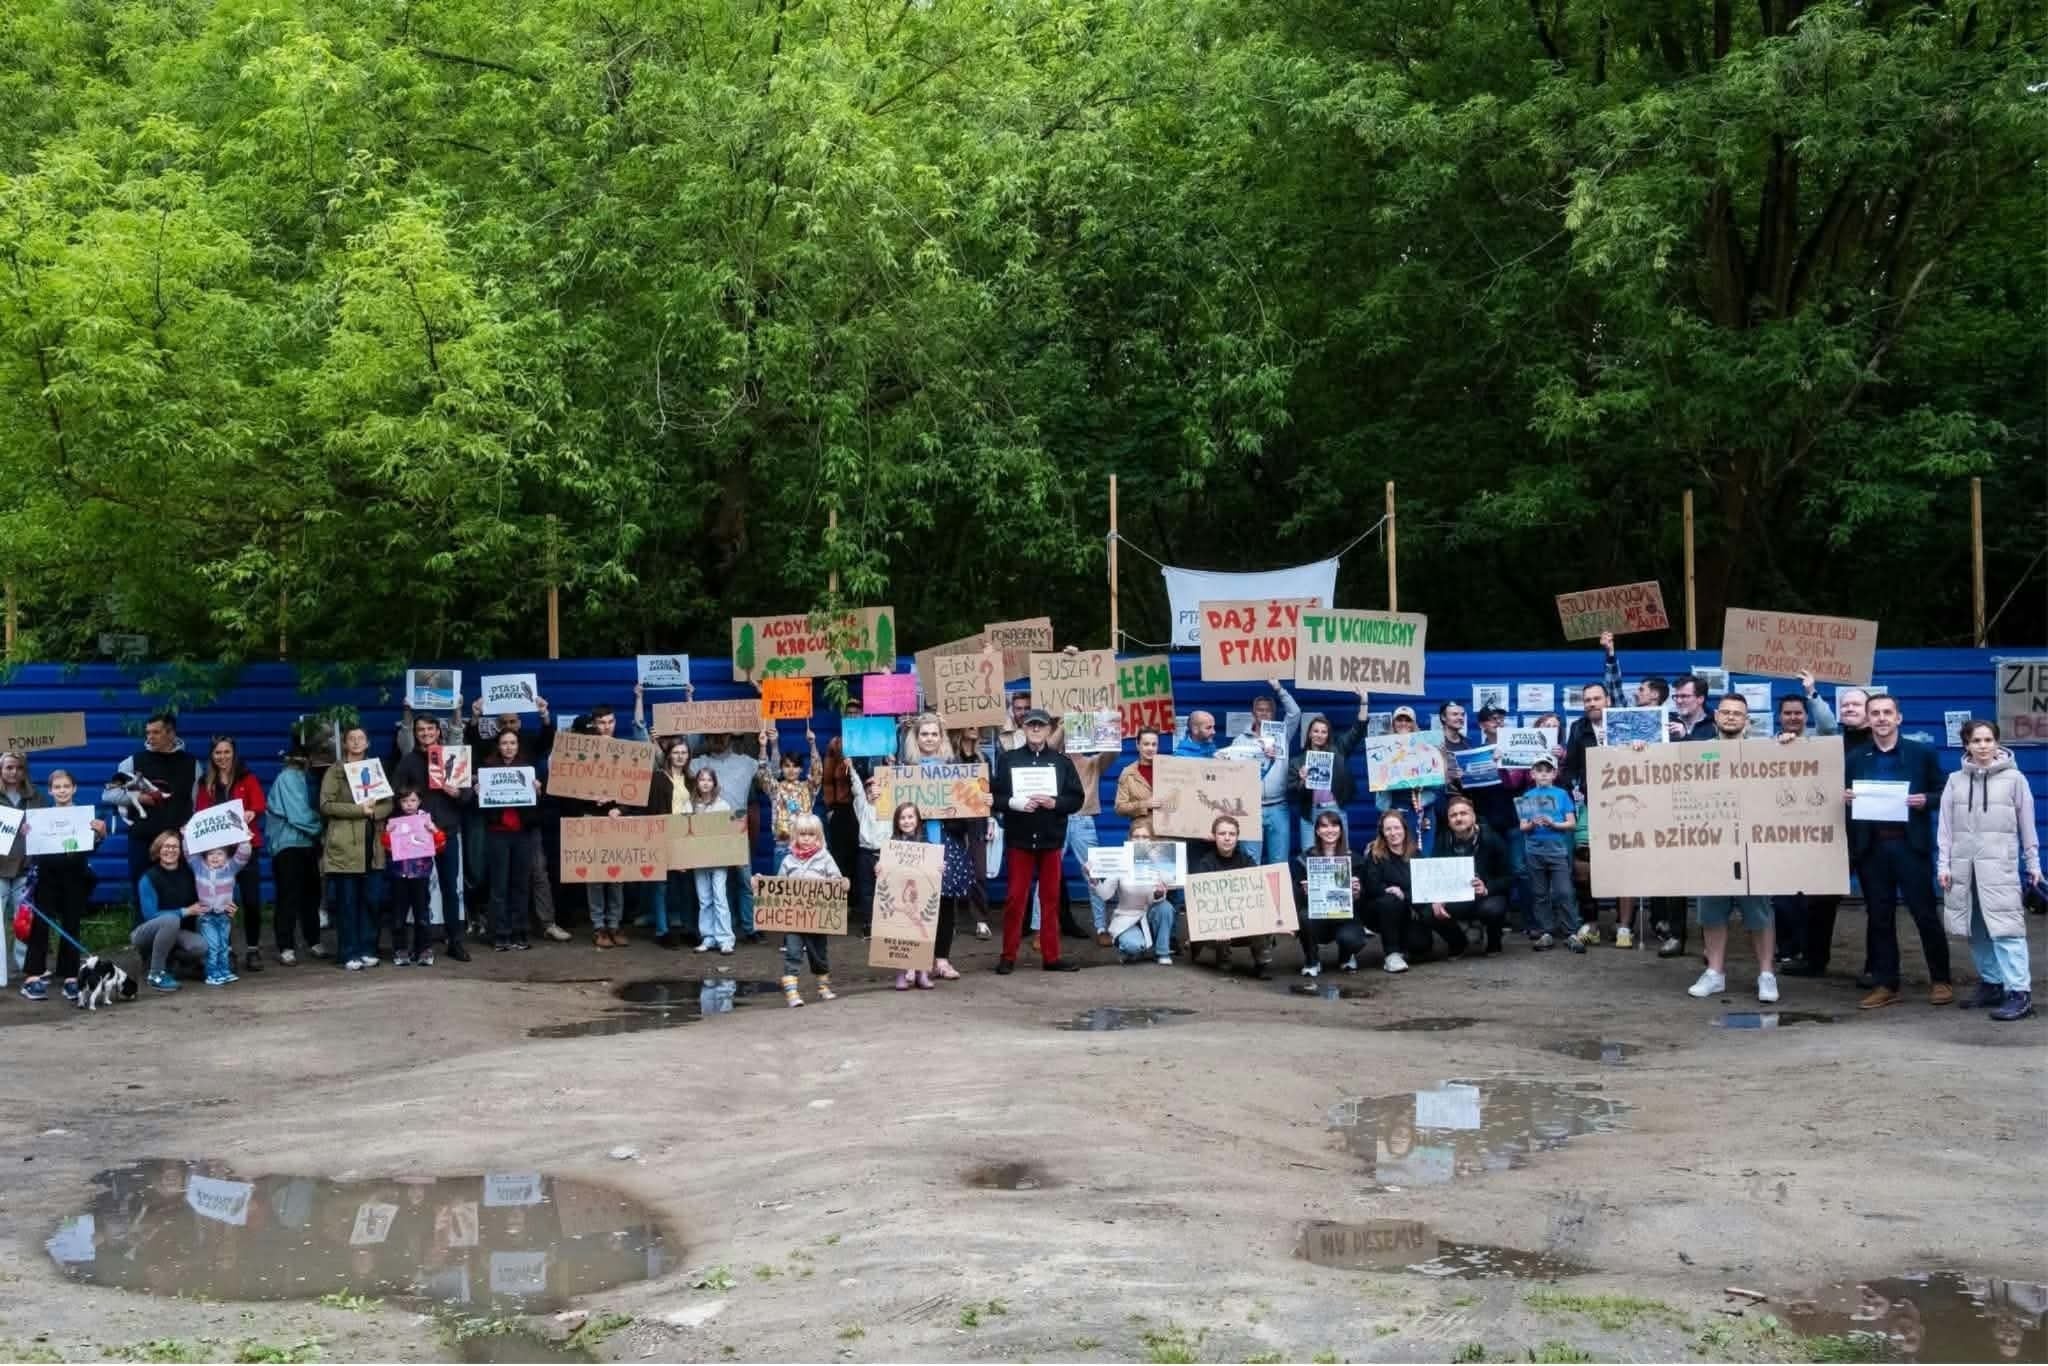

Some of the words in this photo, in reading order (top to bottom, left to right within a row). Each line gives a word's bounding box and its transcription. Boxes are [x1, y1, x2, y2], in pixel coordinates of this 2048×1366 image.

[1206, 607, 1256, 633] DAJ
[1303, 616, 1336, 643] TU
[1745, 616, 1768, 633] NIE
[1219, 637, 1296, 666] PTAKO
[1766, 639, 1785, 655] NA
[1039, 658, 1089, 680] SUSZA
[1308, 655, 1333, 681] NA
[1340, 656, 1411, 686] DRZEWA
[2004, 664, 2048, 693] ZIE
[490, 684, 520, 694] PTASI
[945, 679, 977, 694] CZY
[944, 694, 1002, 714] BETON
[1040, 686, 1109, 710] WYCINKA
[8, 735, 56, 750] PONURY
[892, 765, 914, 779] TU
[921, 764, 980, 780] NADAJE
[1730, 759, 1820, 779] KOLOSEUM
[894, 783, 953, 806] PTASIE
[1608, 829, 1645, 850] DLA
[1653, 821, 1723, 849] DZIKÓW
[1751, 824, 1834, 845] RADNYCH
[564, 849, 597, 864] PTASI
[757, 879, 848, 901] POSŁUCHAJCIE
[783, 897, 816, 910] NAS
[755, 908, 817, 929] CHCEMY
[818, 908, 842, 930] LAS
